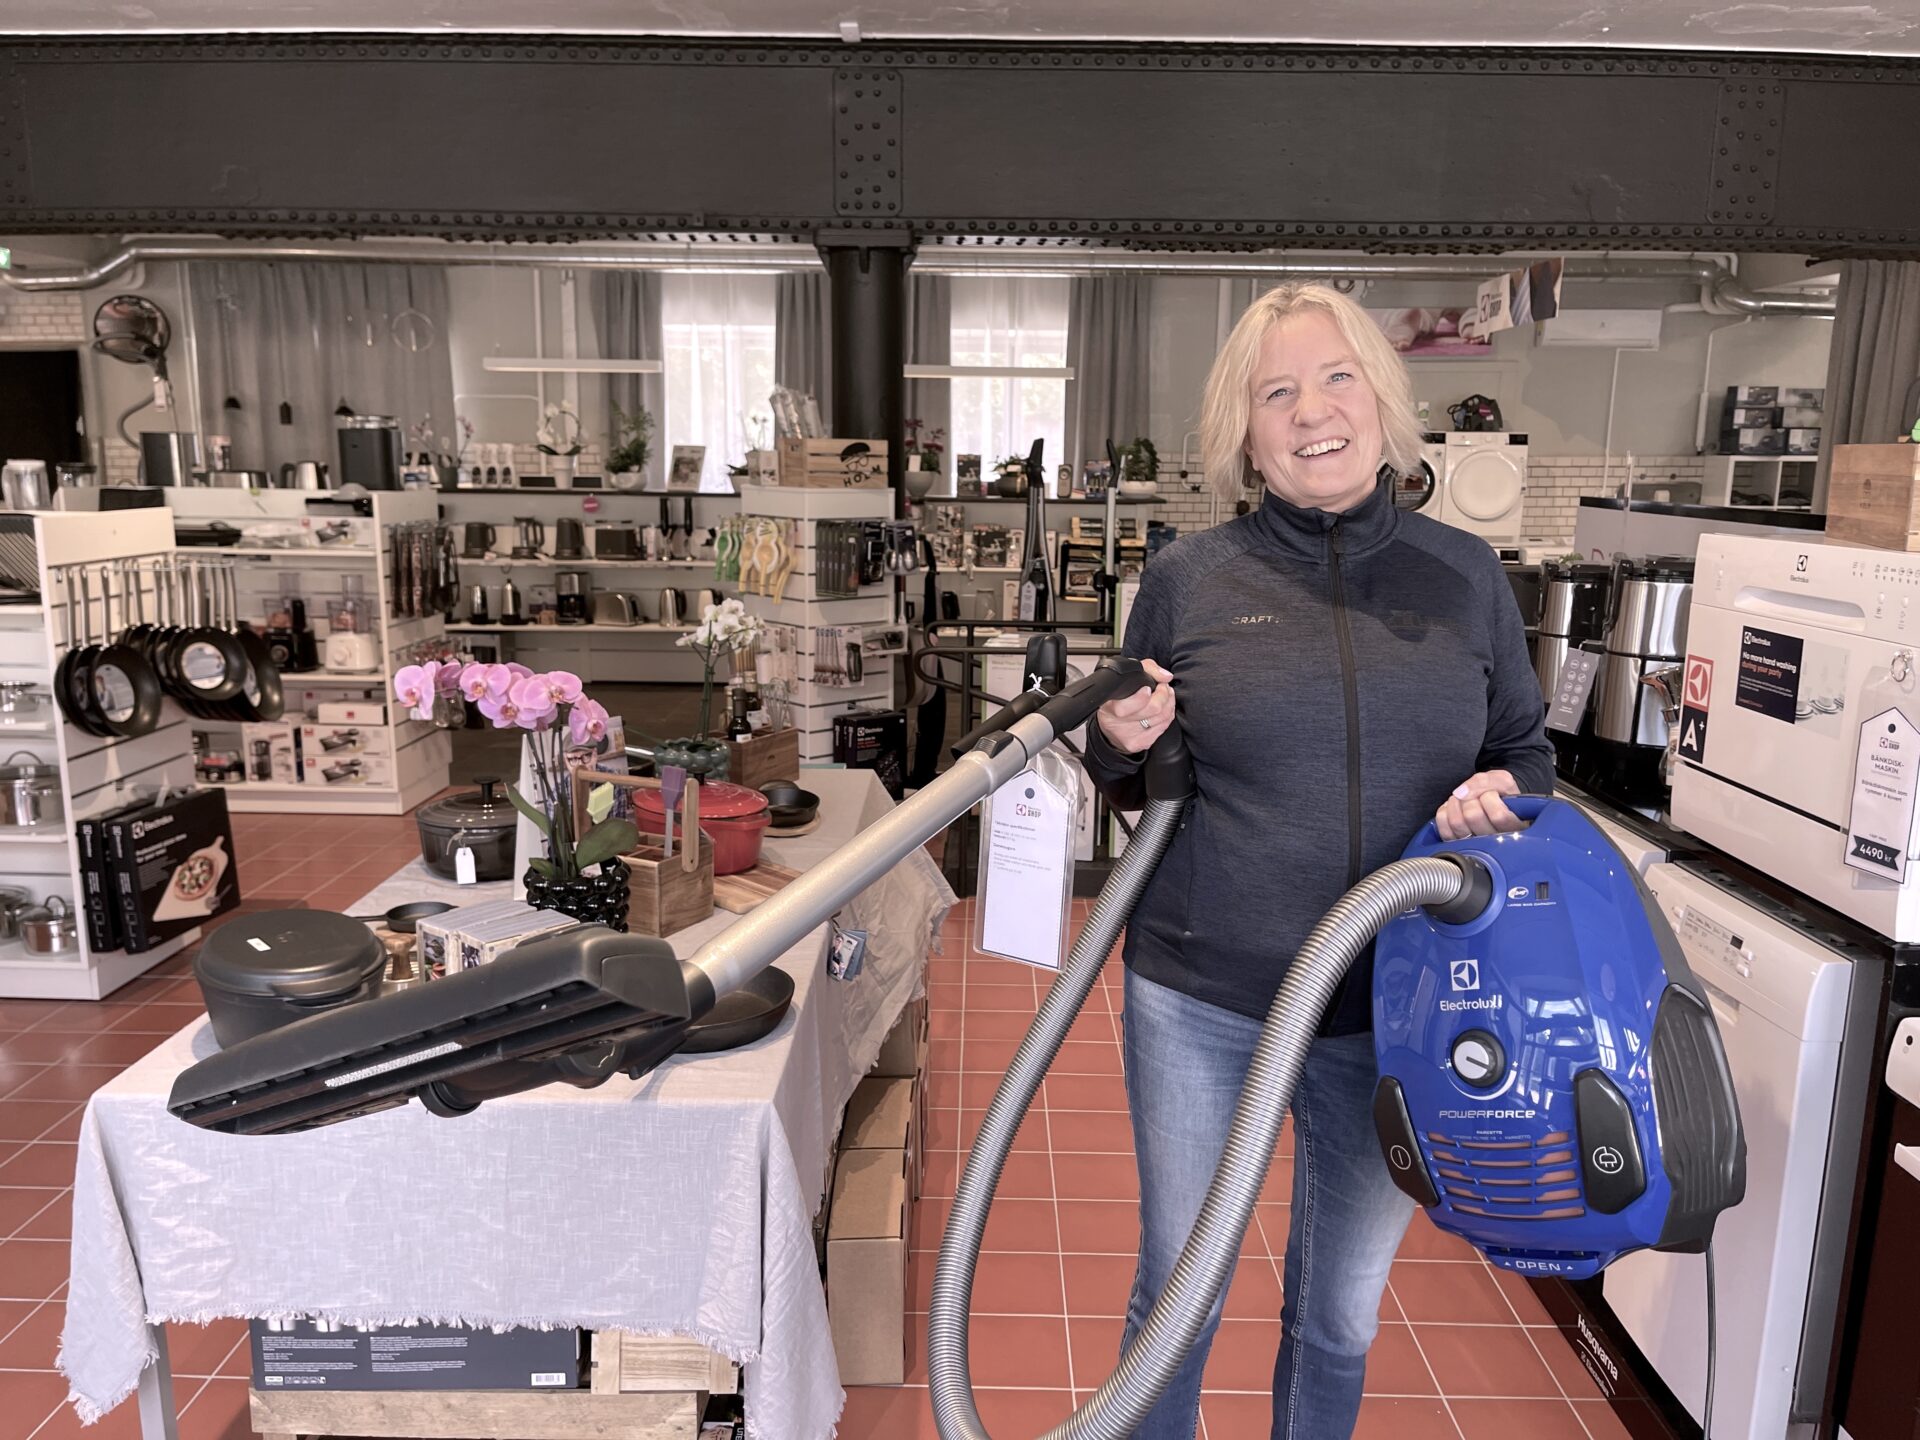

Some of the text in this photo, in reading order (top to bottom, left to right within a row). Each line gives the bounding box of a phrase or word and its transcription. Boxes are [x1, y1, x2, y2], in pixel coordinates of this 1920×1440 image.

[1742, 652, 1797, 674] No more hand washing
[1871, 755, 1904, 767] BÄNKDISK-
[1875, 763, 1899, 774] MASKIN
[1860, 844, 1892, 863] 4490 kr
[1440, 998, 1497, 1011] Electrolux
[1515, 1260, 1561, 1271] OPEN
[1577, 1313, 1618, 1381] Husqvarna
